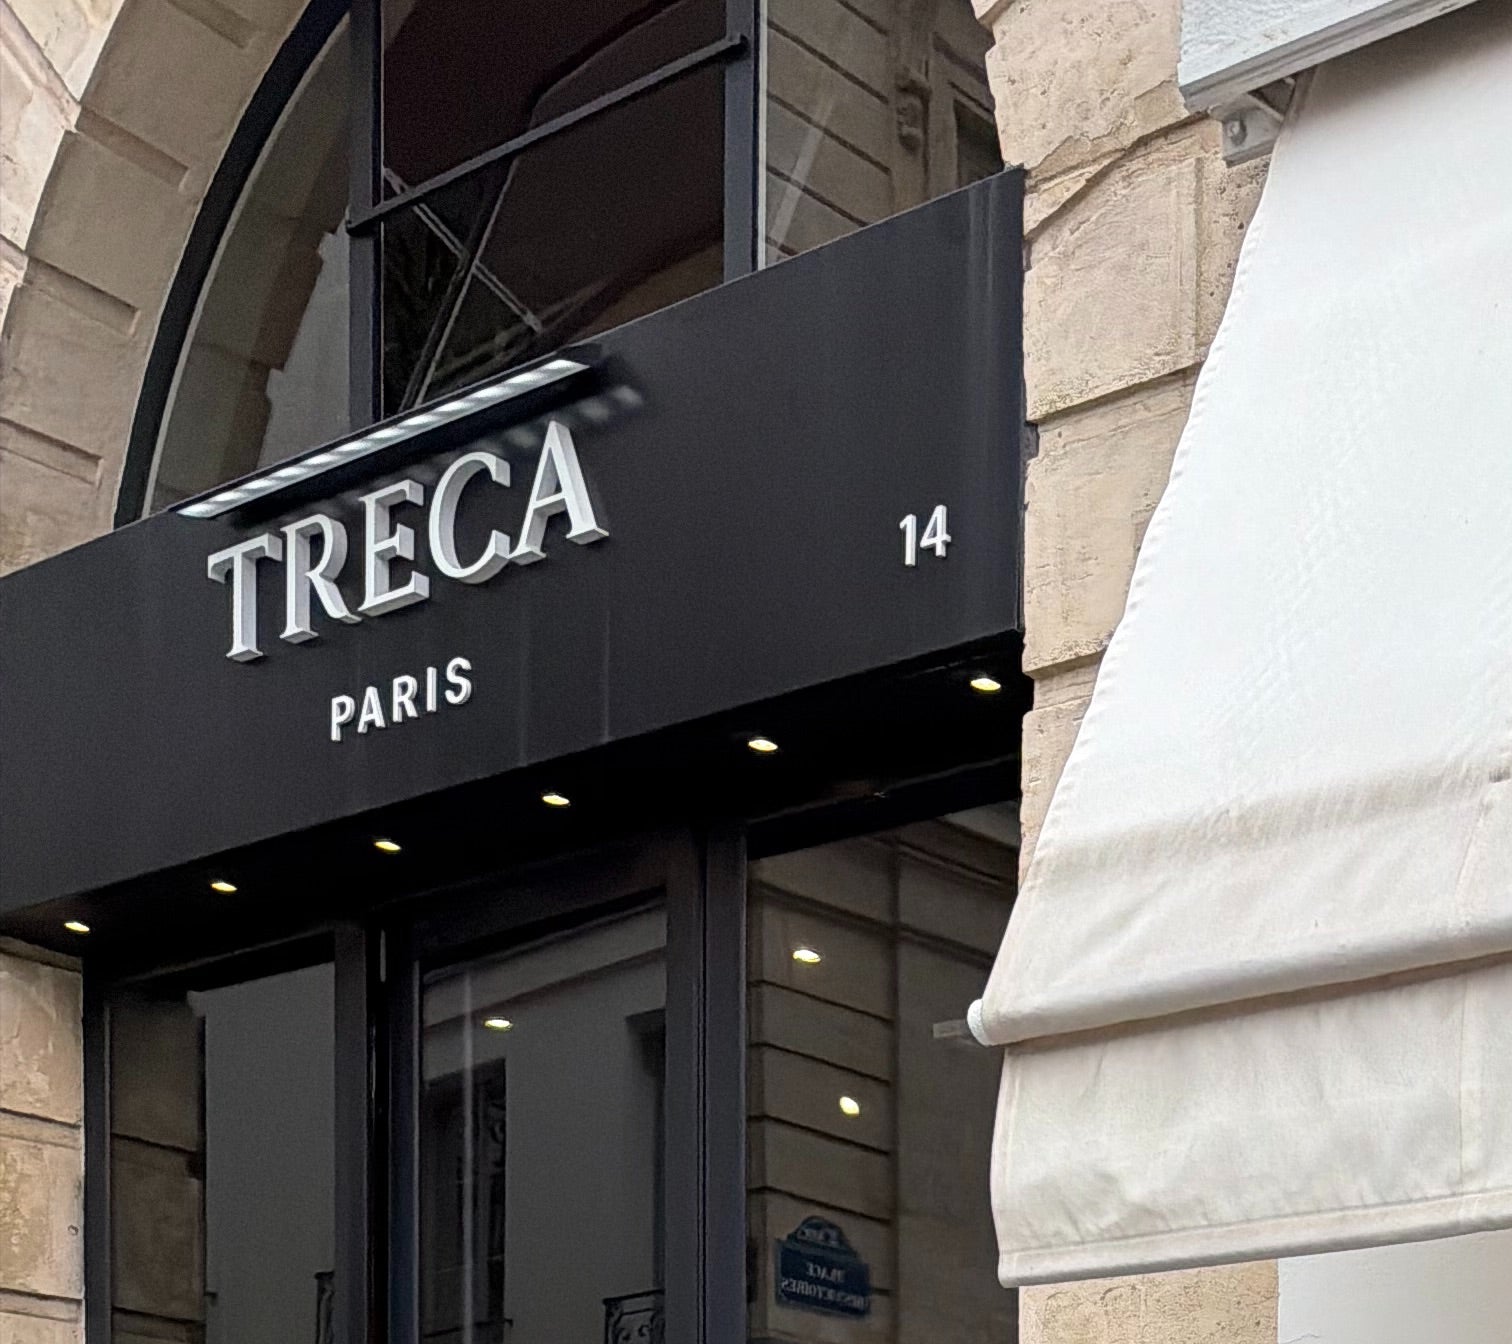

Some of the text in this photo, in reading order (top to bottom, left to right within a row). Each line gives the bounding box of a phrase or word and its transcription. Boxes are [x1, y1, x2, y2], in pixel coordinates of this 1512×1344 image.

[206, 419, 609, 662] TRECA
[899, 505, 952, 566] 14
[331, 657, 473, 741] PARIS
